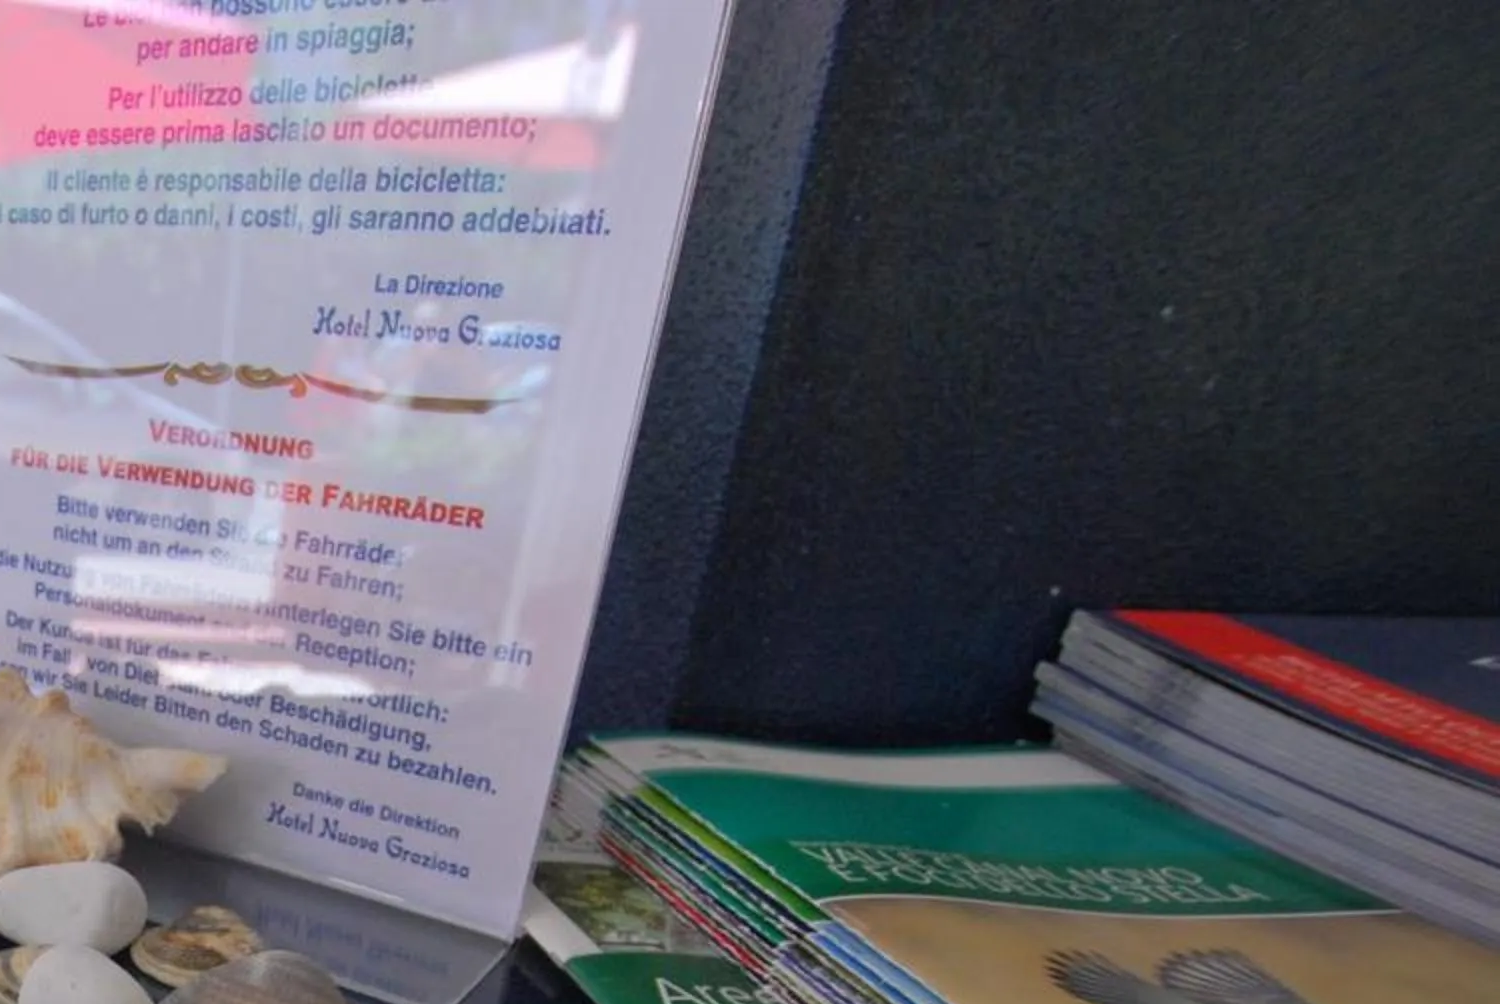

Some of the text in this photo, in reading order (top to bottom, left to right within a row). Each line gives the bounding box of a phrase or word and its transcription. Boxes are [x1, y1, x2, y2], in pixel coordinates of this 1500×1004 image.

[136, 20, 415, 65] per andare in spiaggia;
[108, 86, 145, 111] Per
[150, 80, 243, 108] l'utilizzo
[249, 78, 307, 105] delle
[34, 113, 538, 149] deve essere prima lasciato un documento;
[63, 167, 131, 192] cliente
[154, 167, 302, 197] responsabile
[308, 165, 366, 192] della
[375, 165, 506, 193] bicicletta:
[8, 206, 52, 225] caso
[58, 203, 75, 225] di
[81, 203, 129, 226] furto
[135, 208, 148, 226] o
[155, 203, 220, 229] danni,
[241, 203, 303, 231] costi,
[311, 203, 341, 235] gli
[349, 207, 454, 230] saranno
[462, 205, 610, 236] addebitati.
[374, 273, 504, 299] La Direzione
[313, 305, 370, 338] Hotel
[98, 455, 255, 497] VERWENDUNG
[322, 484, 485, 530] FAHRRÄDER
[57, 496, 99, 520] Bitte
[105, 505, 210, 537] verwenden
[53, 523, 97, 547] nicht
[103, 535, 132, 552] um
[138, 540, 161, 557] an
[283, 564, 309, 584] zu
[316, 565, 405, 602] Fahren;
[6, 609, 34, 631] Der
[24, 553, 97, 587] Nutzu
[387, 620, 426, 646] Sie
[432, 628, 487, 658] bitte
[494, 641, 533, 668] ein
[295, 632, 417, 678] Reception;
[88, 657, 118, 676] von
[270, 693, 432, 753] Beschädigung,
[33, 669, 57, 687] wir
[62, 672, 87, 695] Sie
[94, 679, 148, 710] Leider
[154, 695, 210, 724] Bitten
[216, 710, 253, 733] den
[259, 718, 349, 759] Schaden
[355, 745, 381, 766] zu
[387, 750, 498, 796] bezahlen.
[266, 801, 315, 836] Hotel
[292, 782, 460, 841] Danke die Direktion
